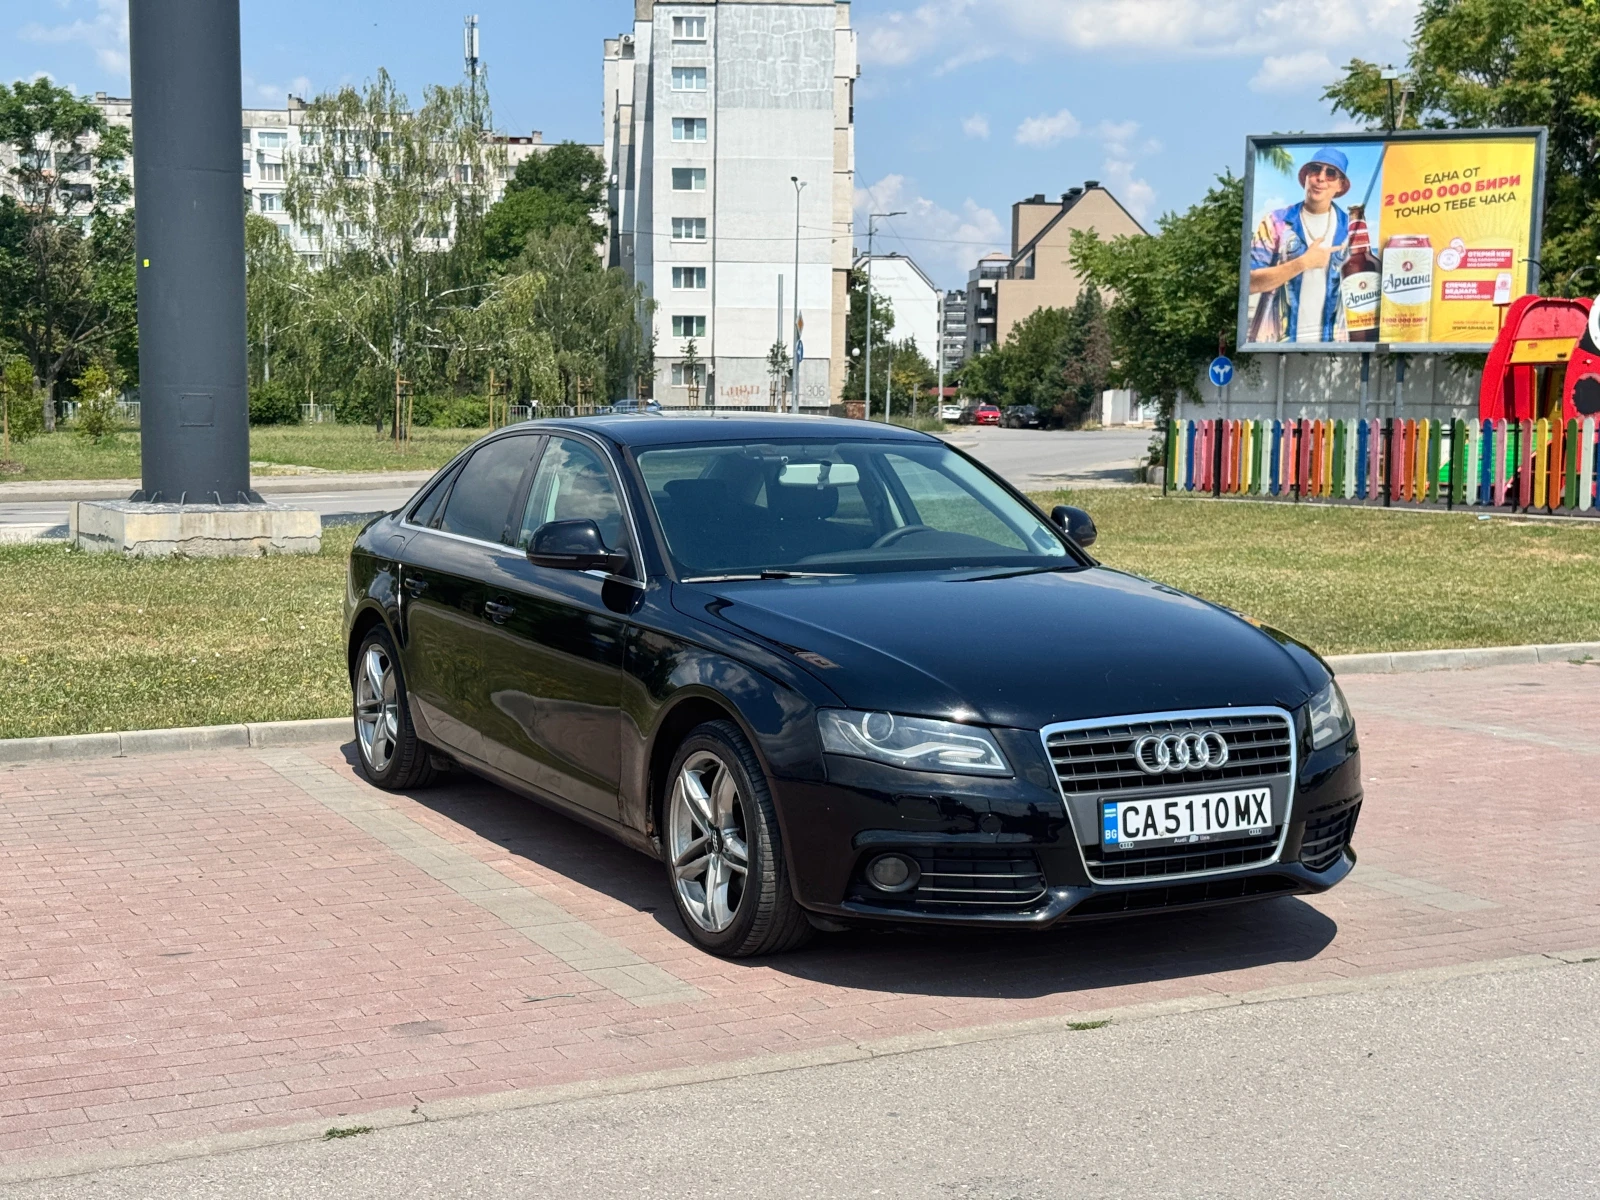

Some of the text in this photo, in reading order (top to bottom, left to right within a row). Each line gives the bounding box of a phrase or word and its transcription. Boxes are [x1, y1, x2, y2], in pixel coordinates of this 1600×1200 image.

[1424, 167, 1481, 185] ЕДНА ОТ
[1384, 174, 1521, 207] 2 000 000 БИРИ
[1394, 191, 1517, 219] ТОЧНО ТЕБЕ ЧАКА
[1383, 273, 1431, 290] Ариана
[1345, 290, 1382, 305] Ариана
[806, 385, 826, 397] 306
[1105, 829, 1117, 839] BG
